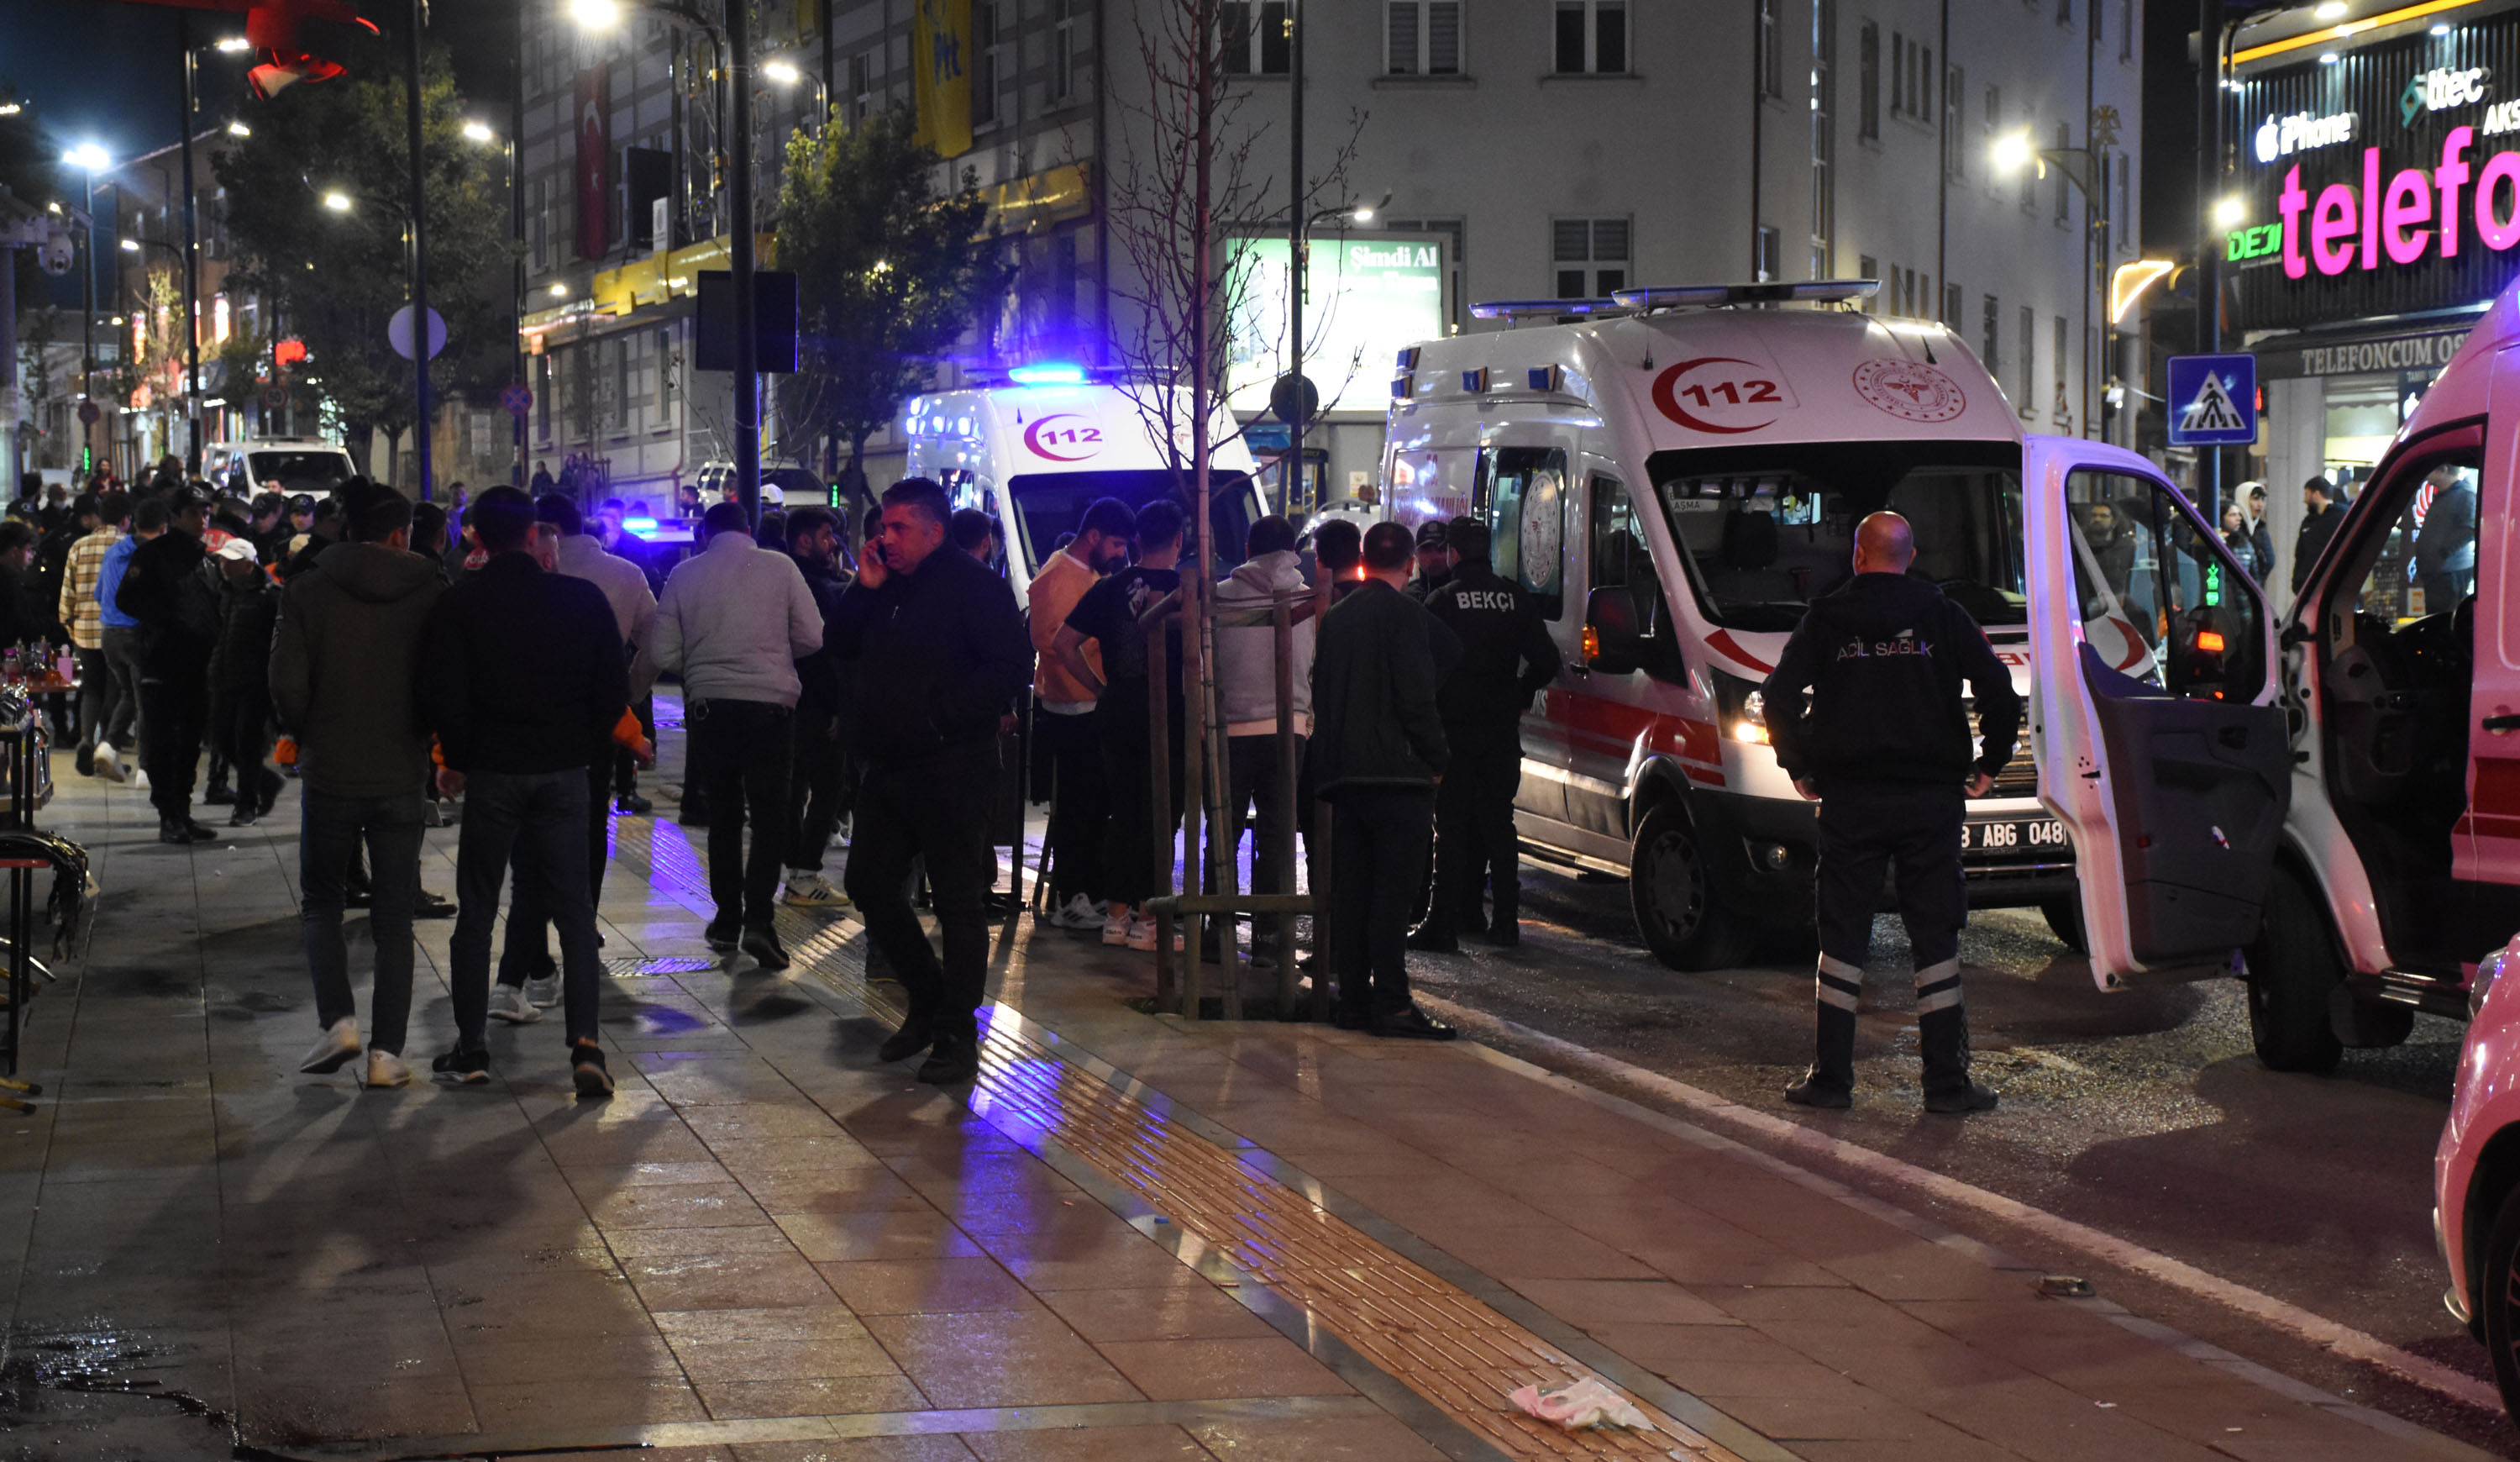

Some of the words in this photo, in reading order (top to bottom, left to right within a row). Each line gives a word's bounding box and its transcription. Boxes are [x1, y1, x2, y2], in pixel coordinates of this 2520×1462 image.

[2280, 111, 2351, 155] iPhone
[2279, 126, 2520, 279] telefo
[1351, 245, 1412, 273] Şimdi
[1413, 245, 1437, 267] Al
[2302, 337, 2433, 375] TELEFONCUM
[1682, 380, 1782, 408] 112
[1042, 428, 1103, 445] 112
[1456, 592, 1515, 612] BEKÇİ
[1982, 823, 2017, 847] ABG
[2029, 821, 2064, 845] 048
